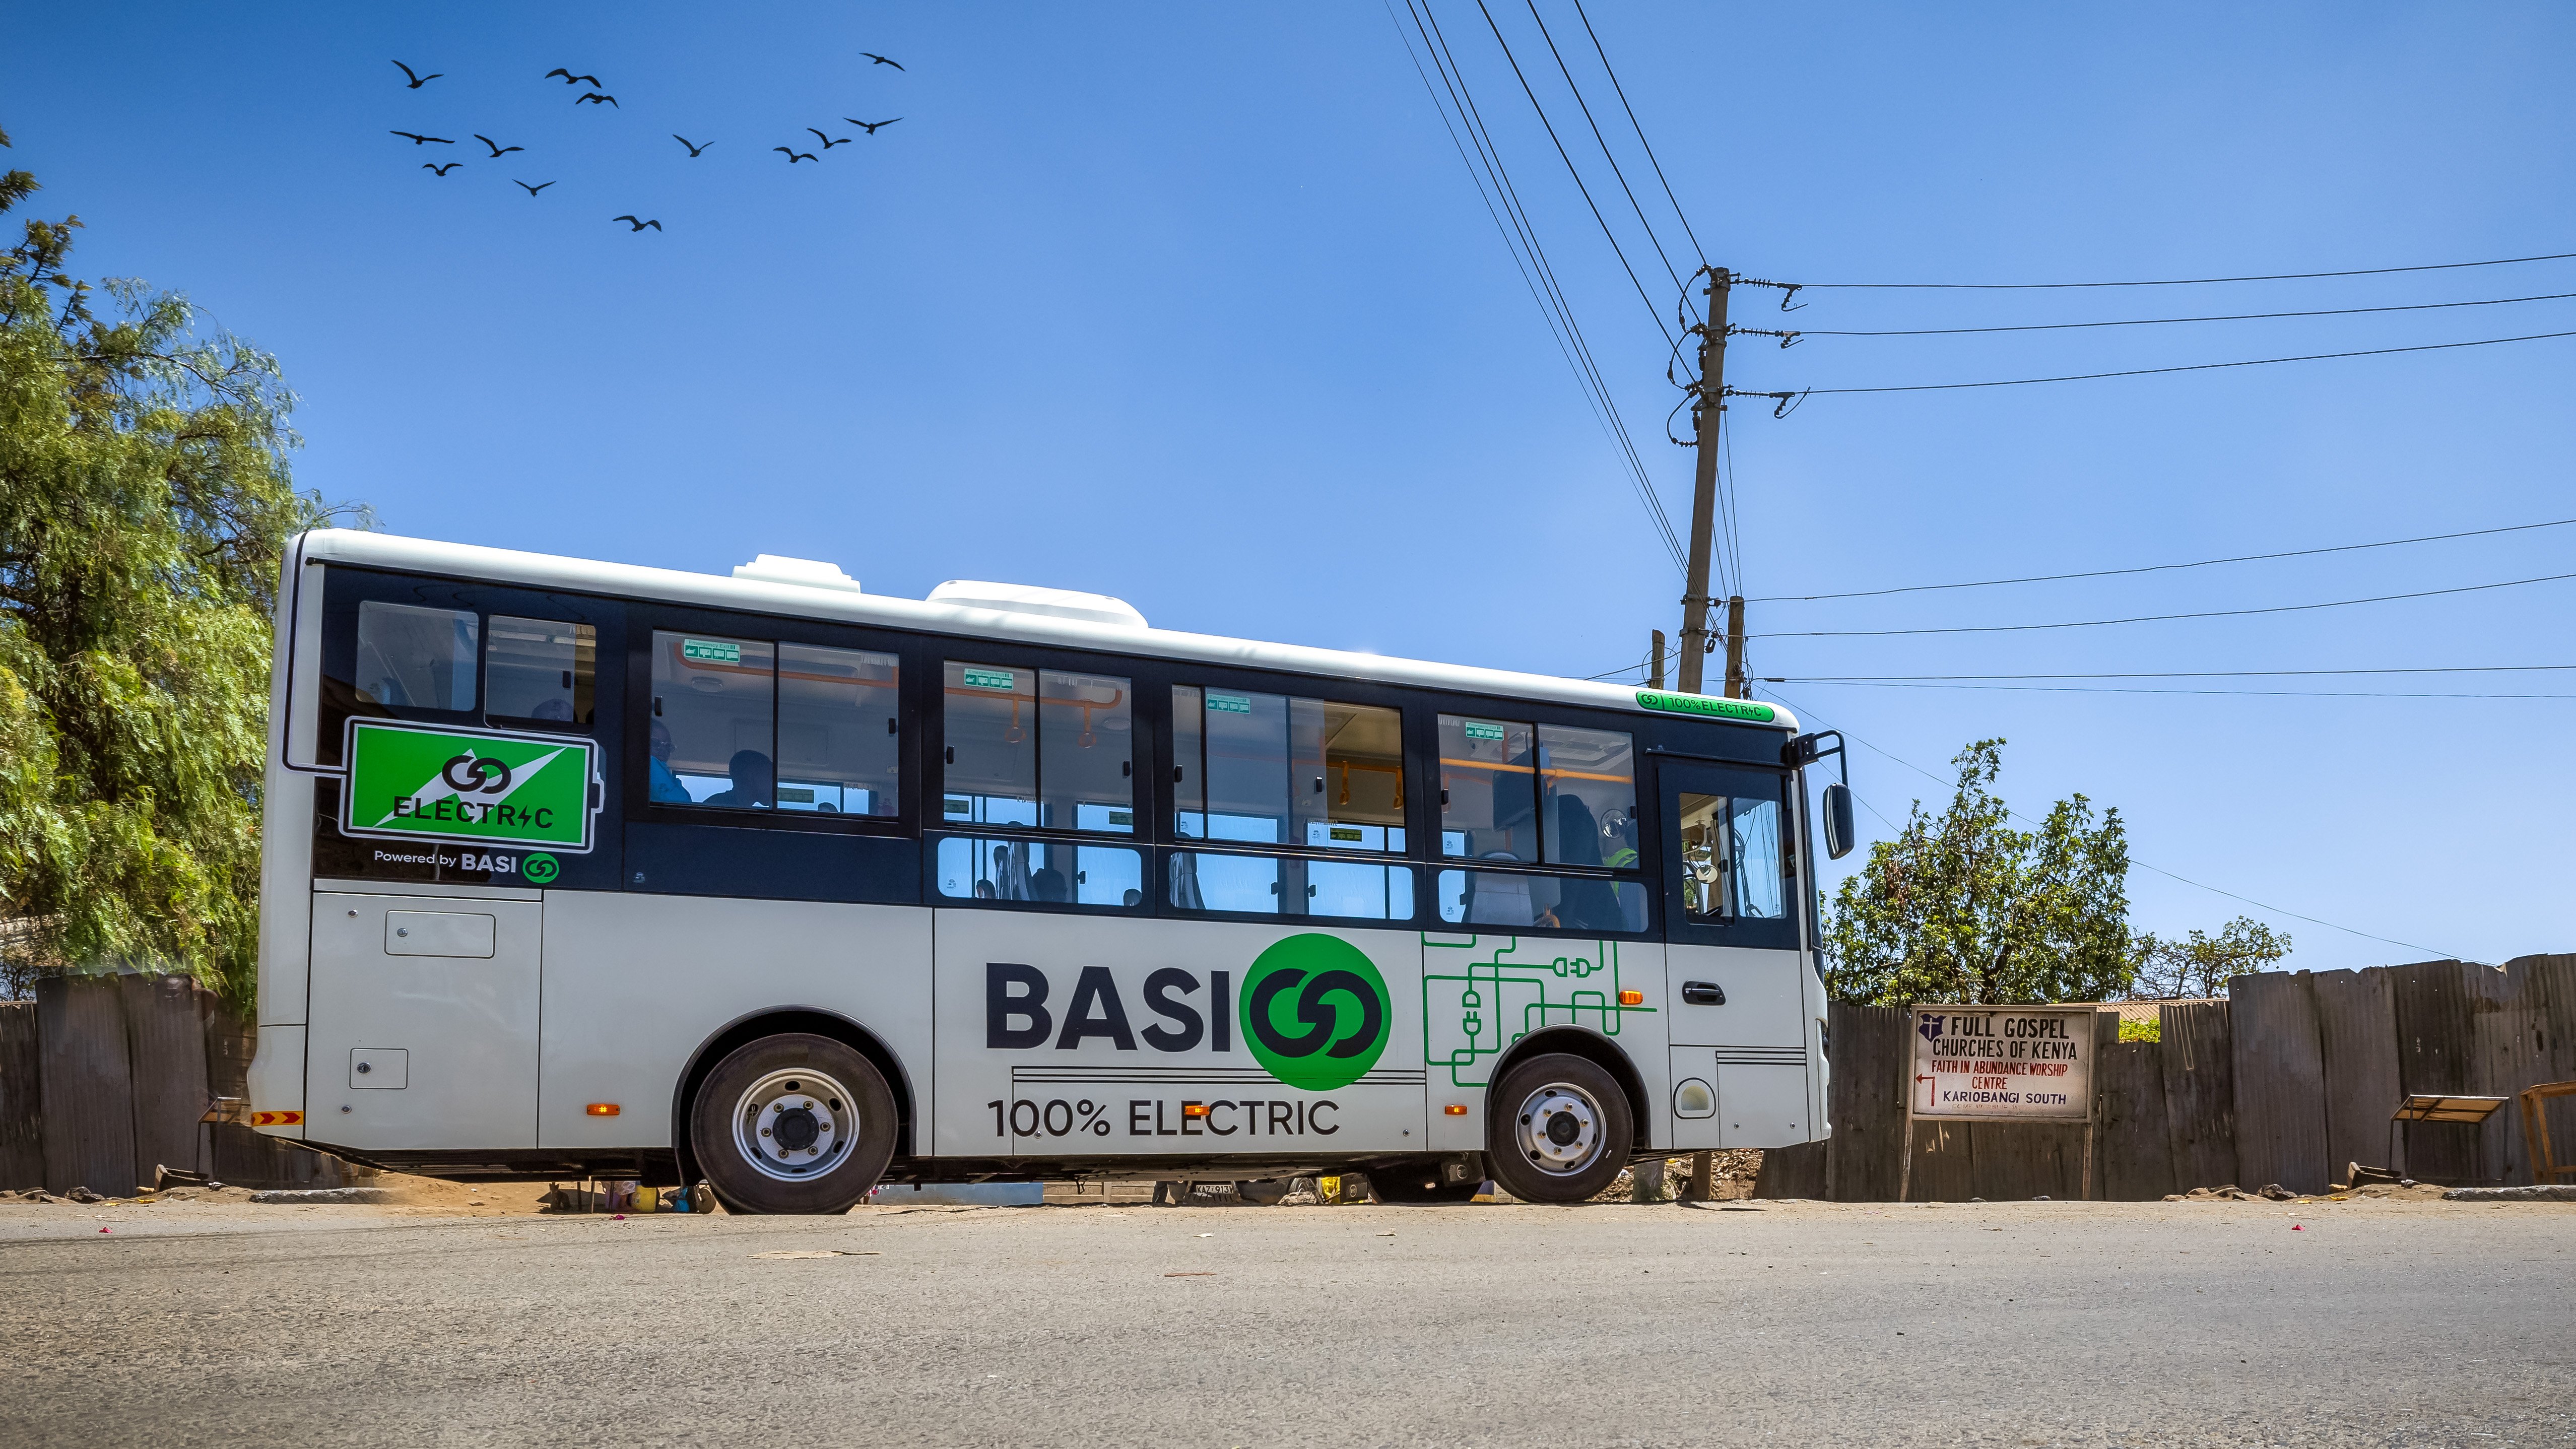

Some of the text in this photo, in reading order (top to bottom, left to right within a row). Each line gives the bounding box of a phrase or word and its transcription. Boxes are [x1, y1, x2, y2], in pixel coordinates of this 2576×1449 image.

[374, 850, 435, 864] Powered
[439, 854, 456, 867] by
[1951, 1016, 2070, 1039] FULL GOSPEL
[1933, 1038, 2077, 1060] CHURCHES OF KENYA
[1932, 1060, 2068, 1077] FAITH IN ABUNDANCE WORSHIP
[1972, 1076, 2008, 1090] CENTRE
[1943, 1091, 2066, 1105] KARIOBANGI SOUTH
[987, 1099, 1340, 1137] 100% ELECTRIC
[1197, 1185, 1210, 1194] KAZ
